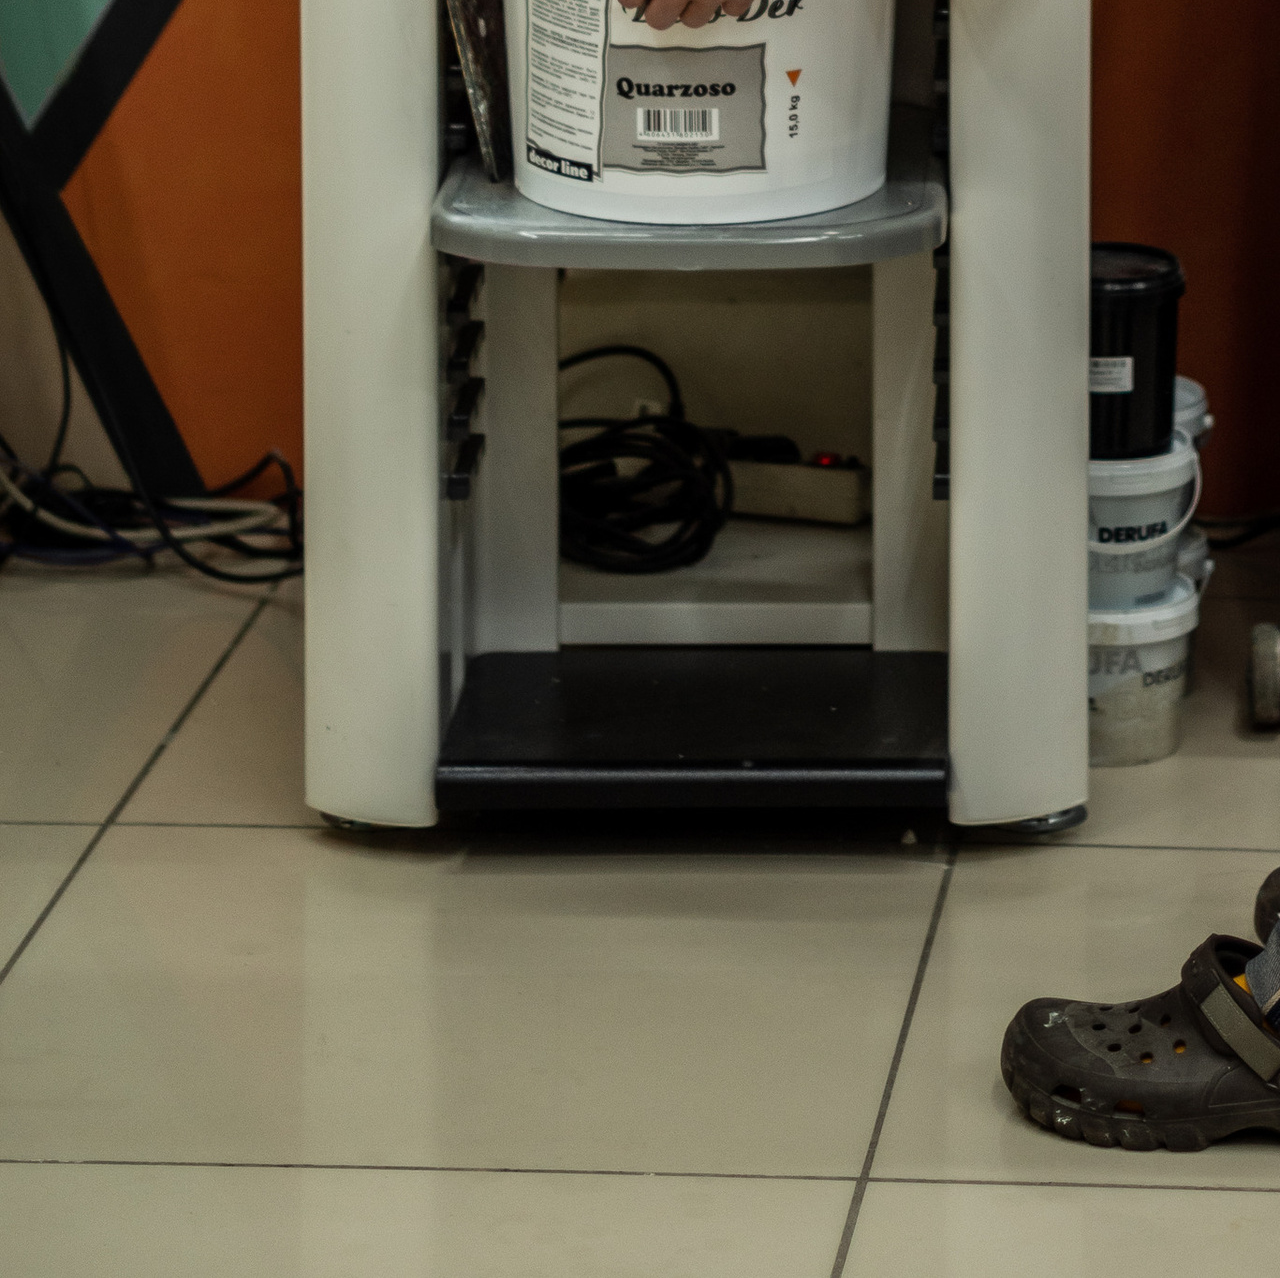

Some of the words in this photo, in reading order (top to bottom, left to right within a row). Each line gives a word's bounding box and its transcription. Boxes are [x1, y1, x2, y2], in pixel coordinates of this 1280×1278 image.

[616, 77, 736, 100] Quarzoso
[788, 95, 801, 111] kg
[788, 113, 800, 139] 15,0
[529, 149, 560, 172] decor
[561, 159, 589, 179] line
[1098, 520, 1168, 543] DERUFA
